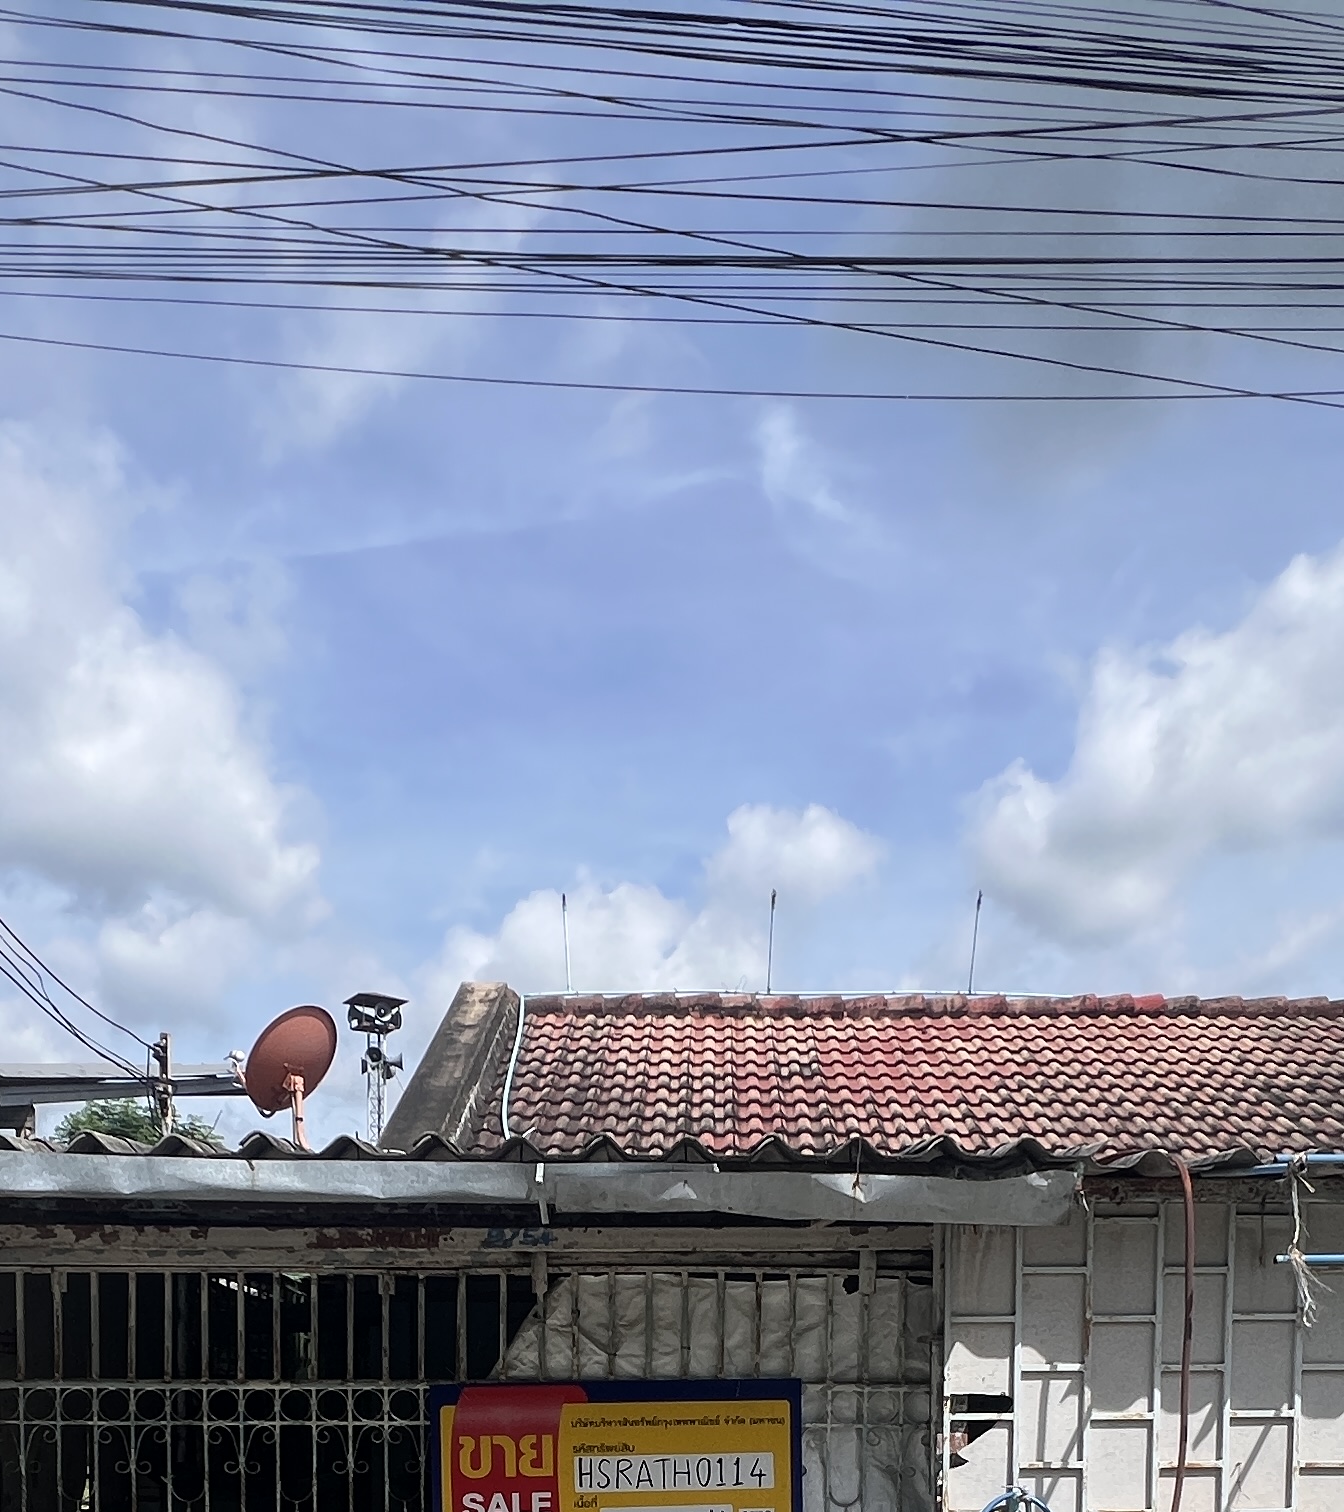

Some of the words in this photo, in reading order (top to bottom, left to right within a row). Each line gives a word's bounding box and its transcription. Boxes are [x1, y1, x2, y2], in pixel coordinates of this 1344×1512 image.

[458, 1434, 555, 1479] ขาย
[577, 1457, 767, 1490] HSRATH0114
[573, 1494, 598, 1509] เนื้อที่
